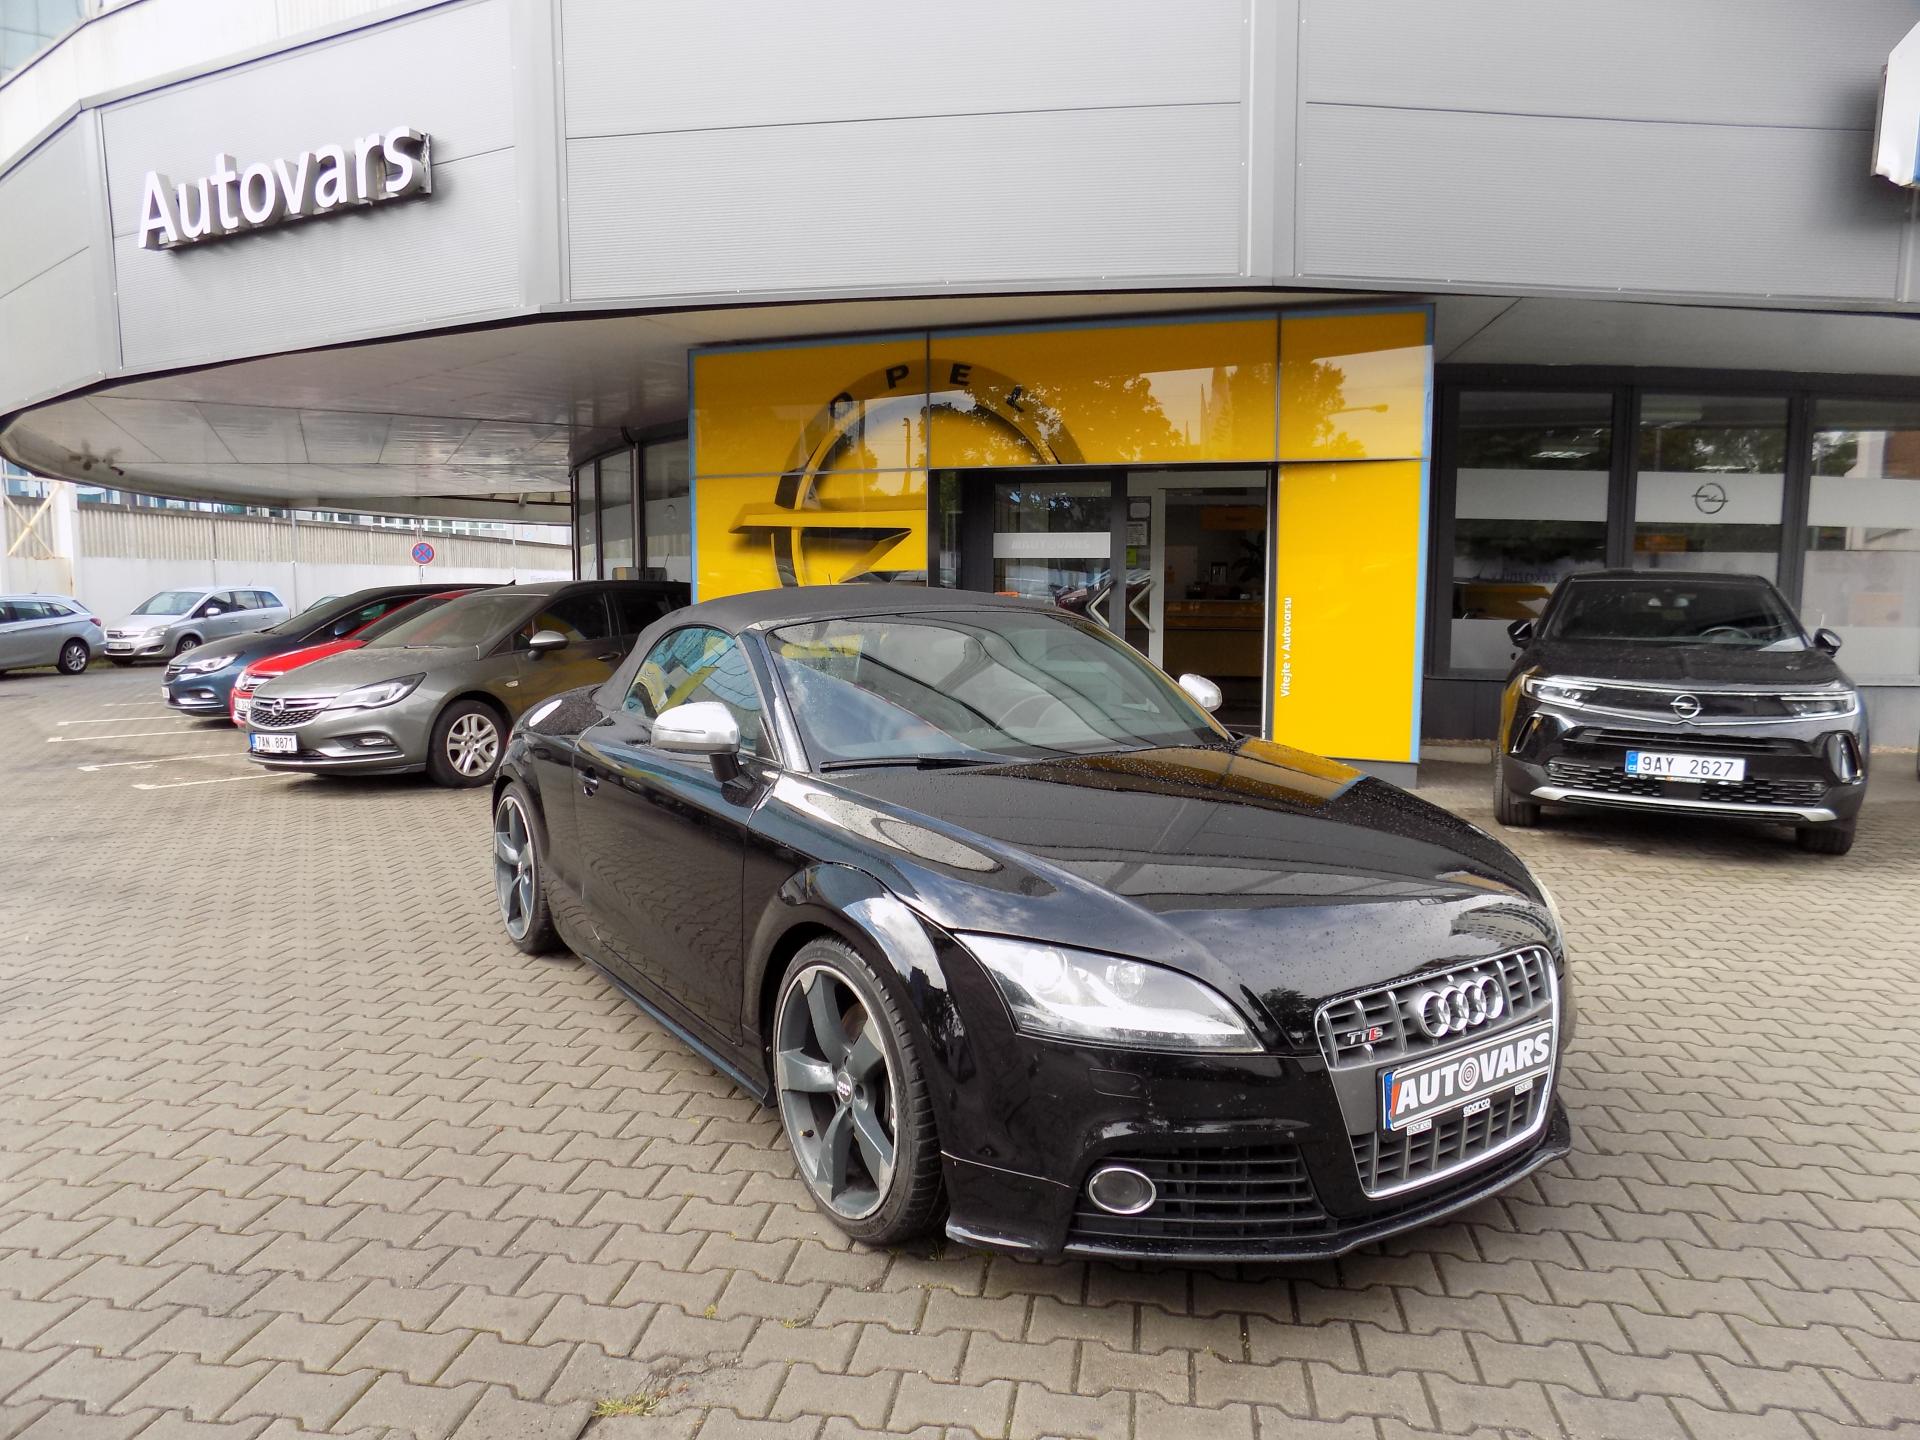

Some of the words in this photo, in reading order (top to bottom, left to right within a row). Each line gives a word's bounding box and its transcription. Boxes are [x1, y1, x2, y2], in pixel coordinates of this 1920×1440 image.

[138, 125, 426, 249] Autovars
[1281, 597, 1293, 652] Autovarsu
[257, 736, 270, 748] 7AN
[275, 737, 293, 749] 8871
[1642, 756, 1674, 773] 9AY
[1689, 759, 1734, 777] 2627
[1396, 1033, 1550, 1115] AUTOVARS
[1463, 1099, 1490, 1117] sparco
